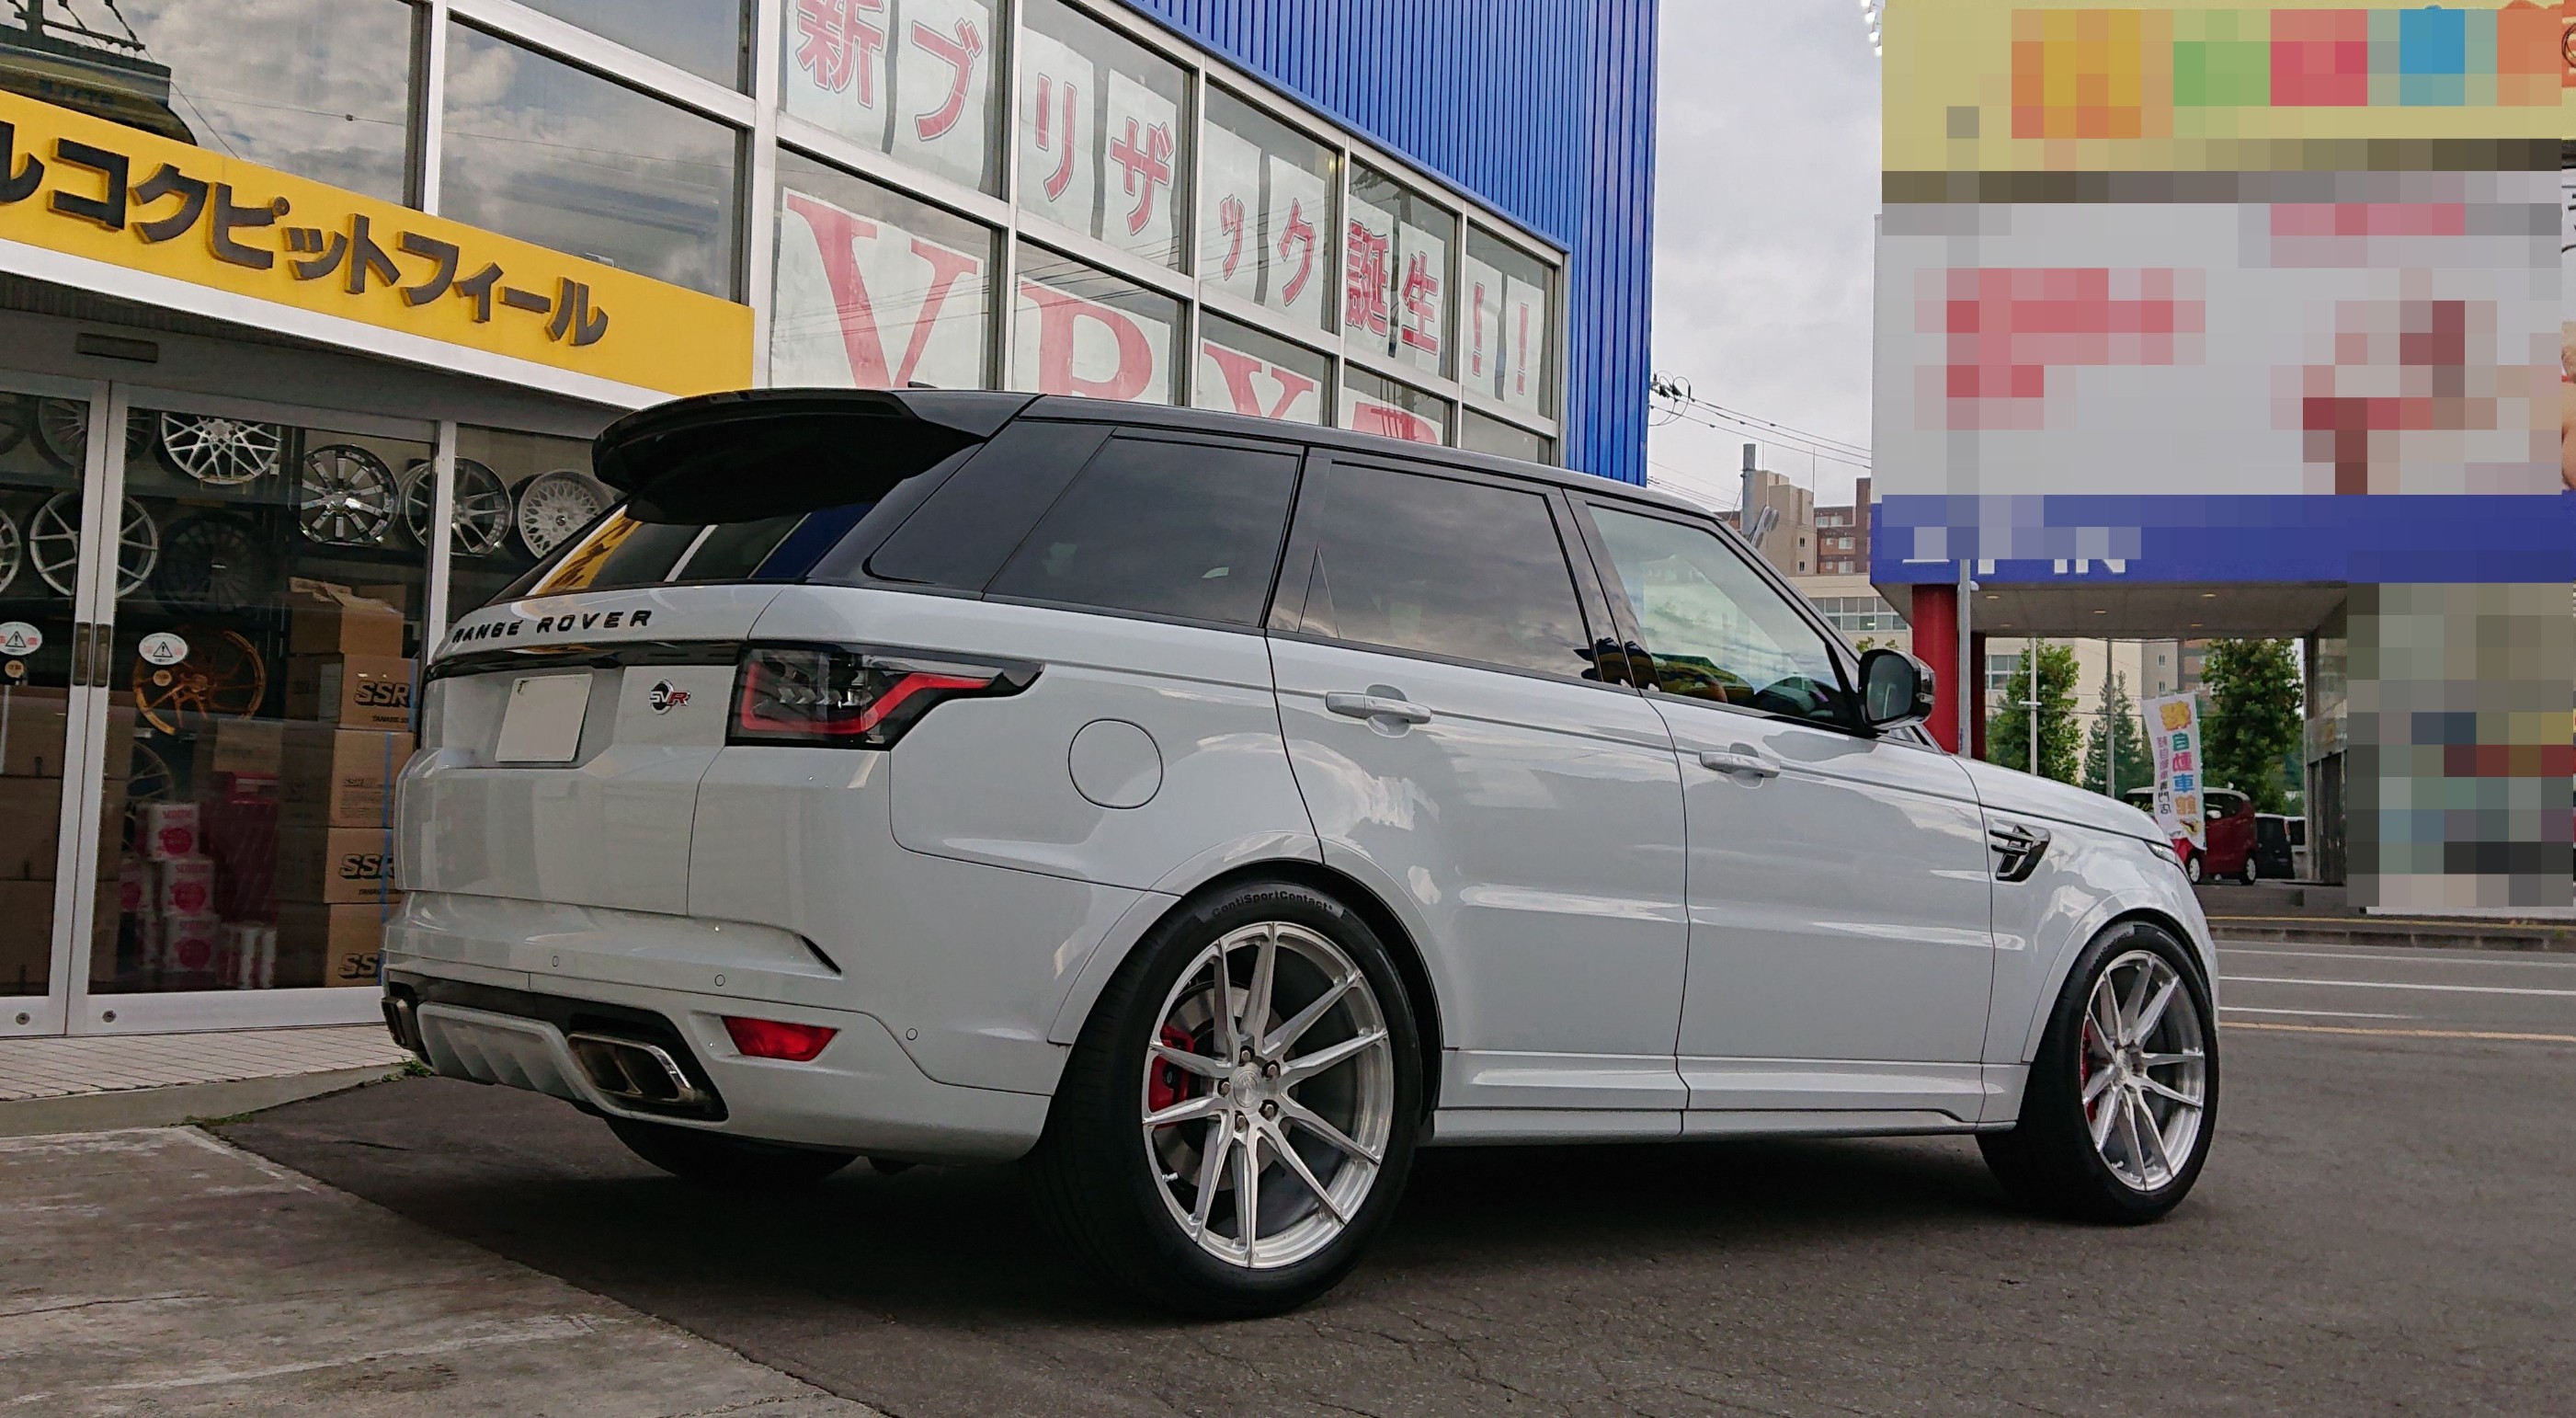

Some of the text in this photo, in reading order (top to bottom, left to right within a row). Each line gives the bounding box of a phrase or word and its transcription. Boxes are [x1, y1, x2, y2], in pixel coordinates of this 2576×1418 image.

[451, 610, 653, 644] RANGE ROVER
[353, 680, 412, 708] SSR
[648, 690, 691, 707] SVR
[1212, 890, 1333, 918] ContiSportContact
[337, 953, 380, 978] SS
